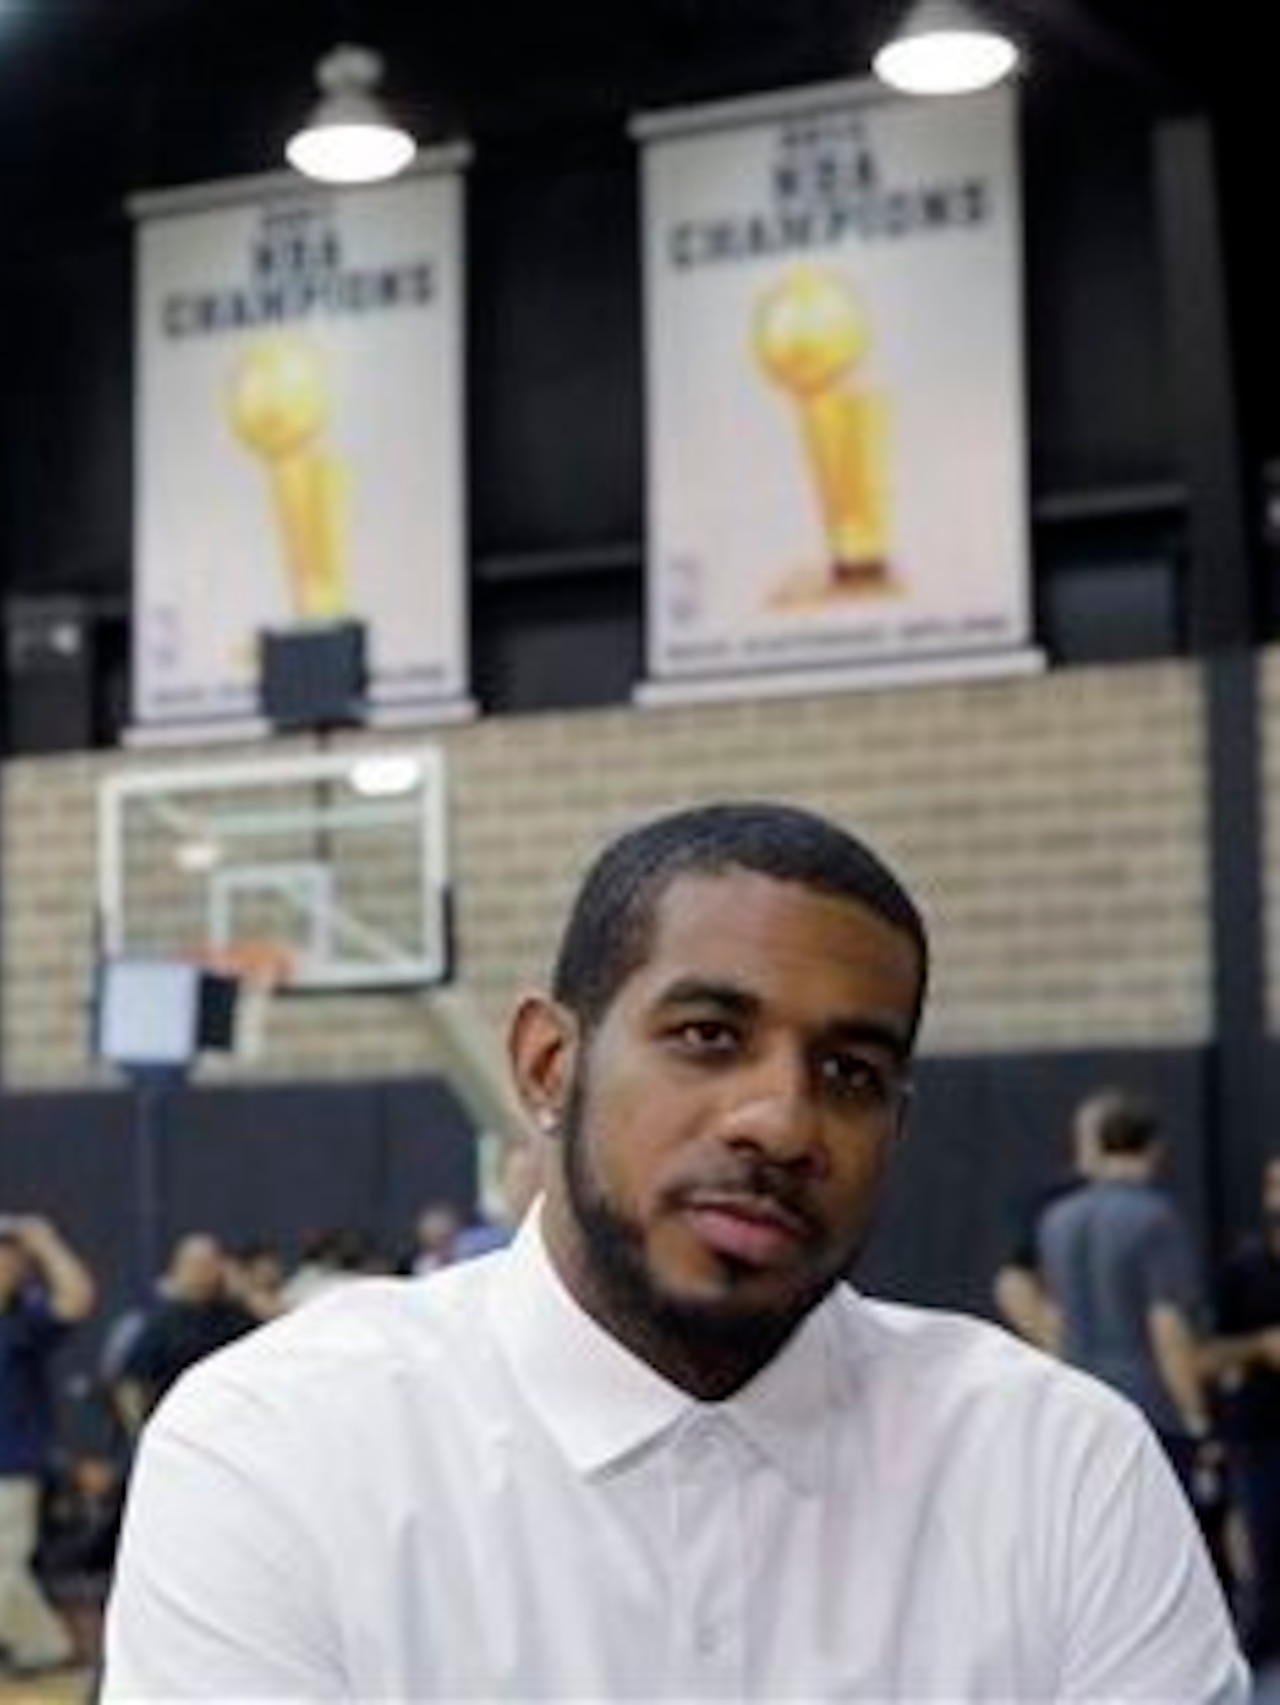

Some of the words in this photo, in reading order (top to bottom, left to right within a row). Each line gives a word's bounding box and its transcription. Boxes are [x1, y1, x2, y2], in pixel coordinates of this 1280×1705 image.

[775, 149, 876, 200] NBA
[670, 180, 990, 269] CHAMPIONS
[162, 263, 434, 339] CHAMPIONS
